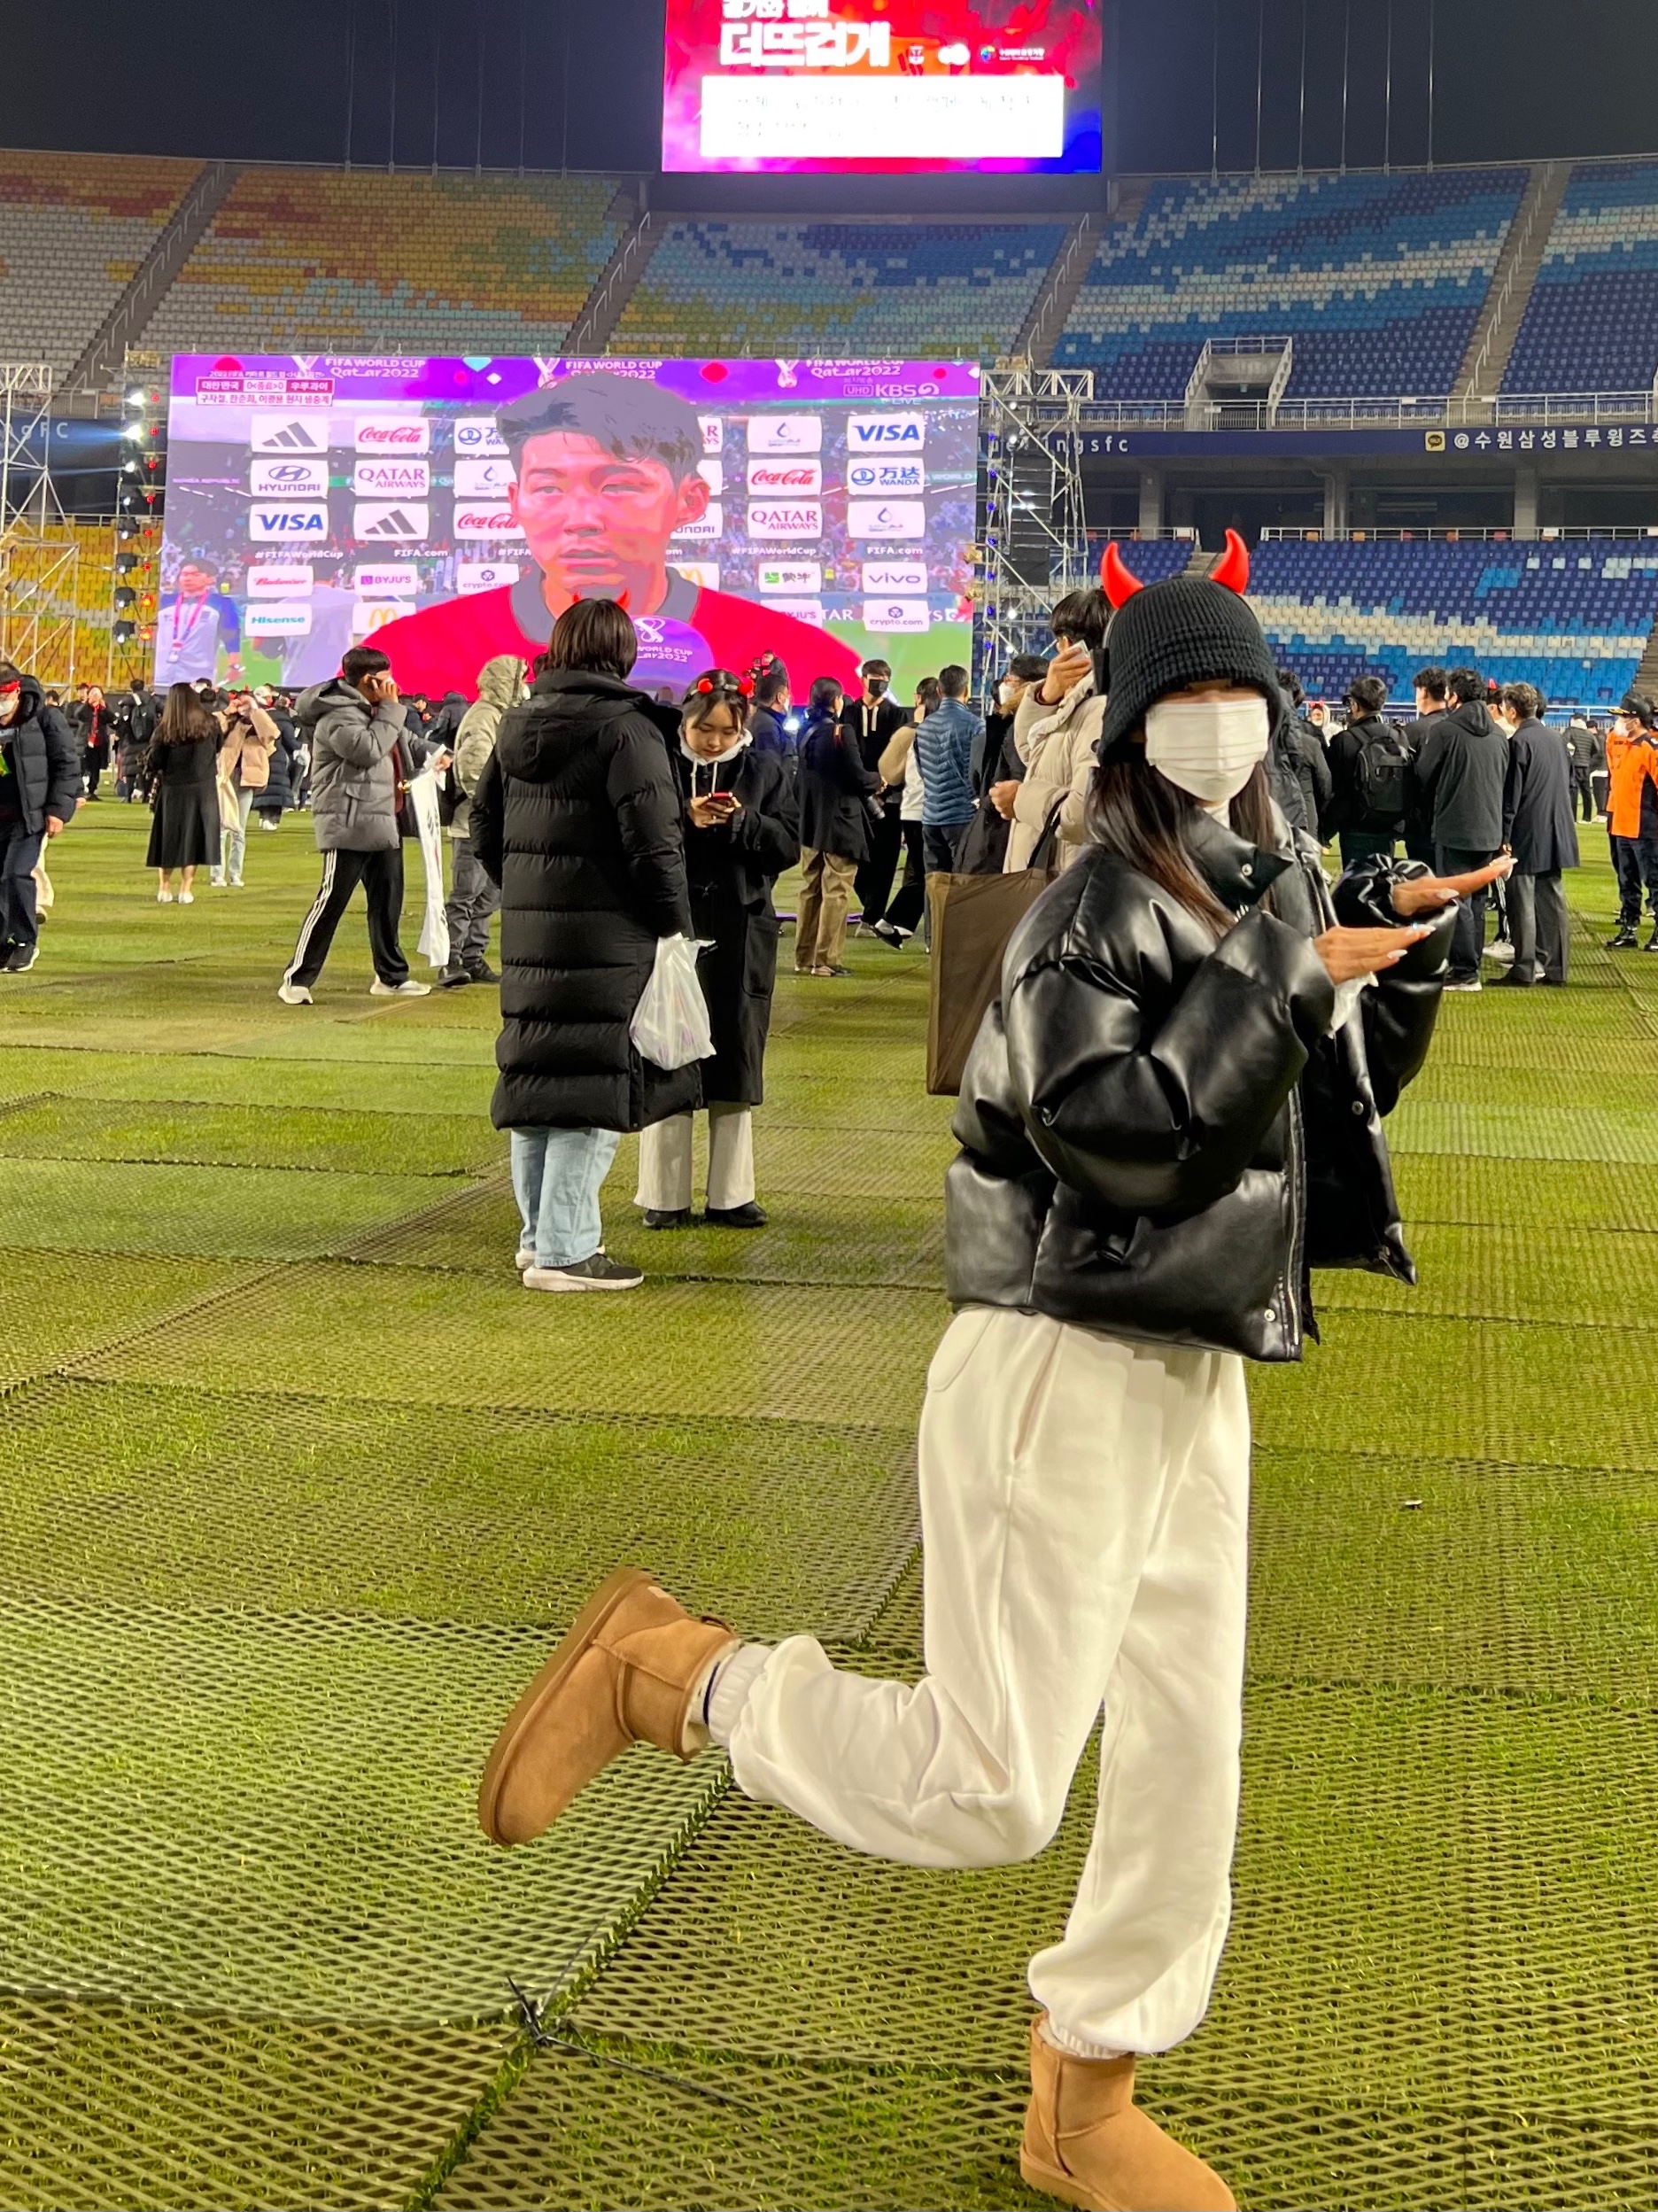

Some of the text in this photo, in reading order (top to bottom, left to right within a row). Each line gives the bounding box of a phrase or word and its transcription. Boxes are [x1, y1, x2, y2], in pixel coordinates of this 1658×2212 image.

[325, 358, 426, 369] FIFA WORLD CUP
[565, 361, 592, 369] FIFA
[593, 361, 637, 369] WORLD
[201, 380, 239, 391] 대한민국
[291, 381, 328, 392] 우루과이
[875, 384, 917, 397] KBS
[852, 424, 920, 441] VISA
[358, 468, 425, 482] QATAR
[879, 467, 920, 479] 万达
[255, 514, 324, 531] VISA
[751, 510, 817, 524] QATAR
[254, 550, 344, 560] #FIFAWorldCup
[732, 547, 817, 556] #FIFAWorldCup
[673, 648, 693, 656] CUP
